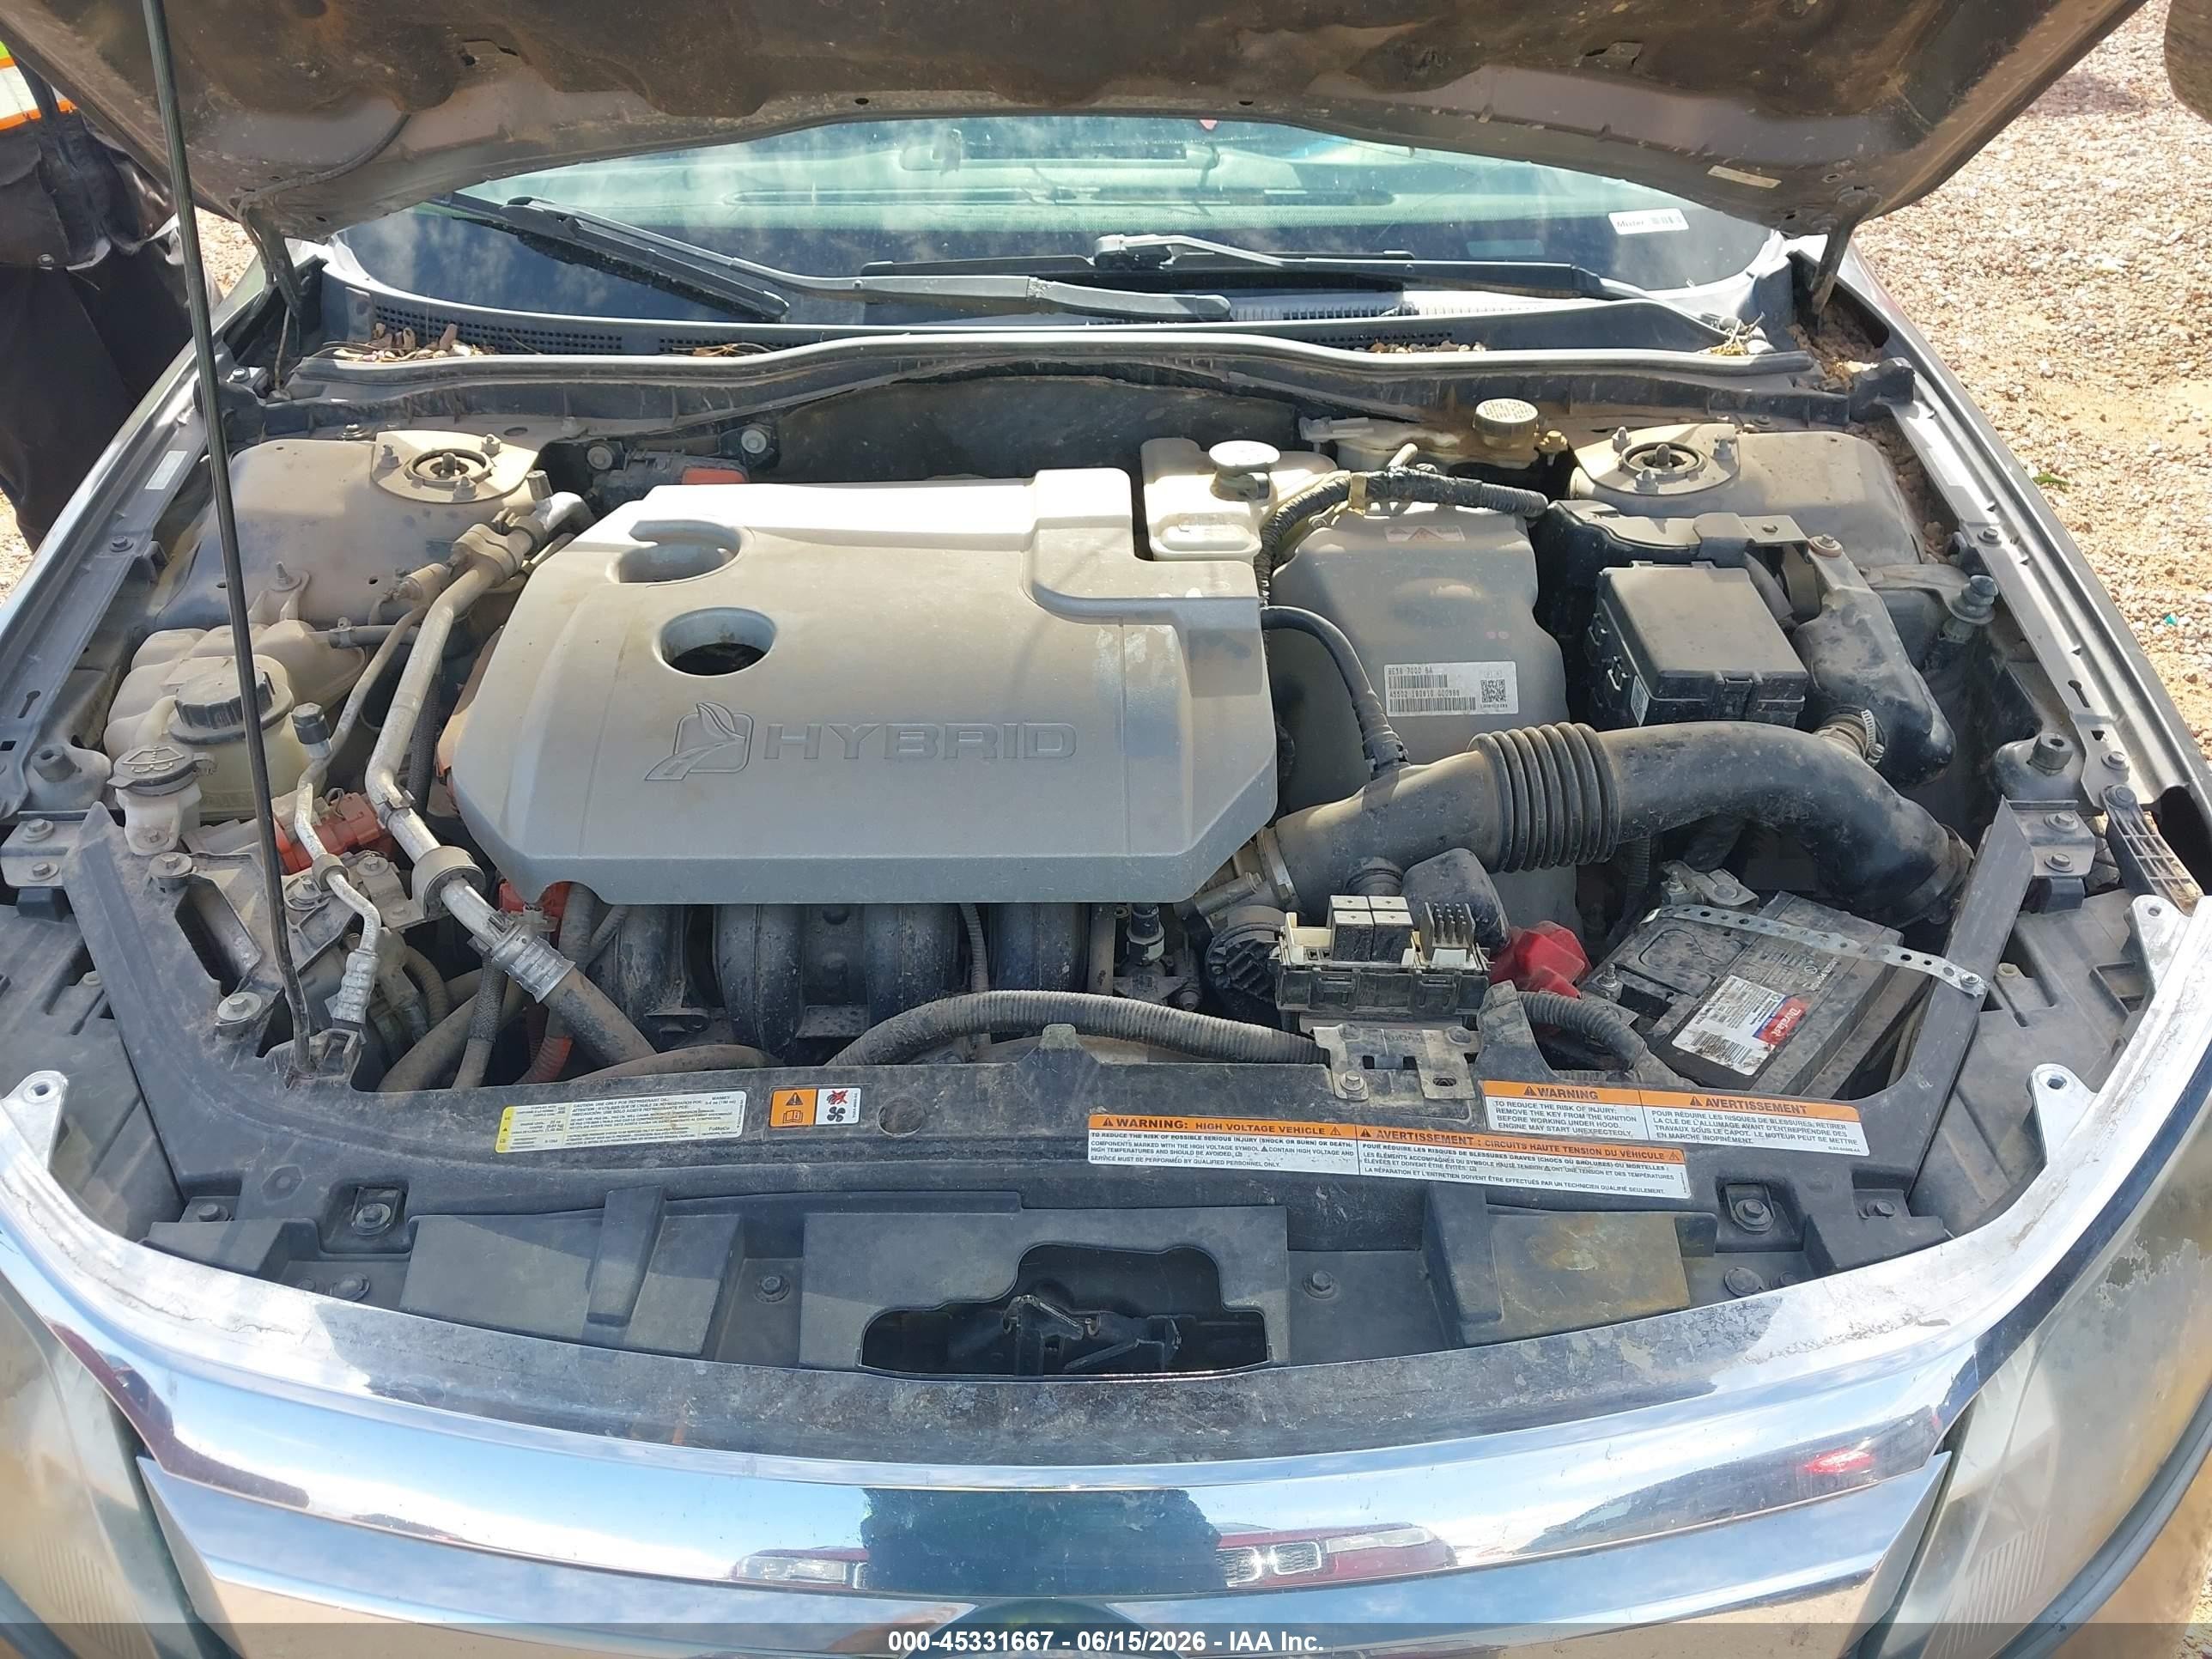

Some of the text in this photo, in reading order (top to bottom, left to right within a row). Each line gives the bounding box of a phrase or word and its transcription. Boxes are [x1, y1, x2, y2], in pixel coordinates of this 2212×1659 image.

[763, 722, 1077, 760] HYBRID
[1536, 1087, 1598, 1100] WARNING
[1705, 1097, 1807, 1115] AVERTISSEMENT
[1116, 1117, 1325, 1134] WARNING: HIGH VOLTAGE VEHICLE
[1529, 1116, 1565, 1125] WORKING
[1674, 1110, 1706, 1119] RÉDUIRE
[1817, 1121, 1846, 1130] RETIRER
[1692, 1120, 1740, 1128] L'ALLUMAGE
[1765, 1125, 1830, 1136] D'ENTREPRENDRE
[1668, 1132, 1699, 1140] MARCHE
[1765, 1132, 1796, 1140] MOTEUR
[1829, 1137, 1858, 1146] METTRE
[1377, 1129, 1474, 1145] AVERTISSEMENT
[1485, 1139, 1527, 1149] CIRCUITS
[1529, 1142, 1559, 1152] HAUTE
[1563, 1145, 1601, 1155] TENSION
[1605, 1148, 1616, 1157] DU
[1620, 1148, 1664, 1160] VÉHICULE
[1626, 1163, 1664, 1171] MORTELLES
[1422, 1170, 1459, 1179] L'ENTRETIEN
[1565, 1181, 1599, 1189] TECHNICIEN
